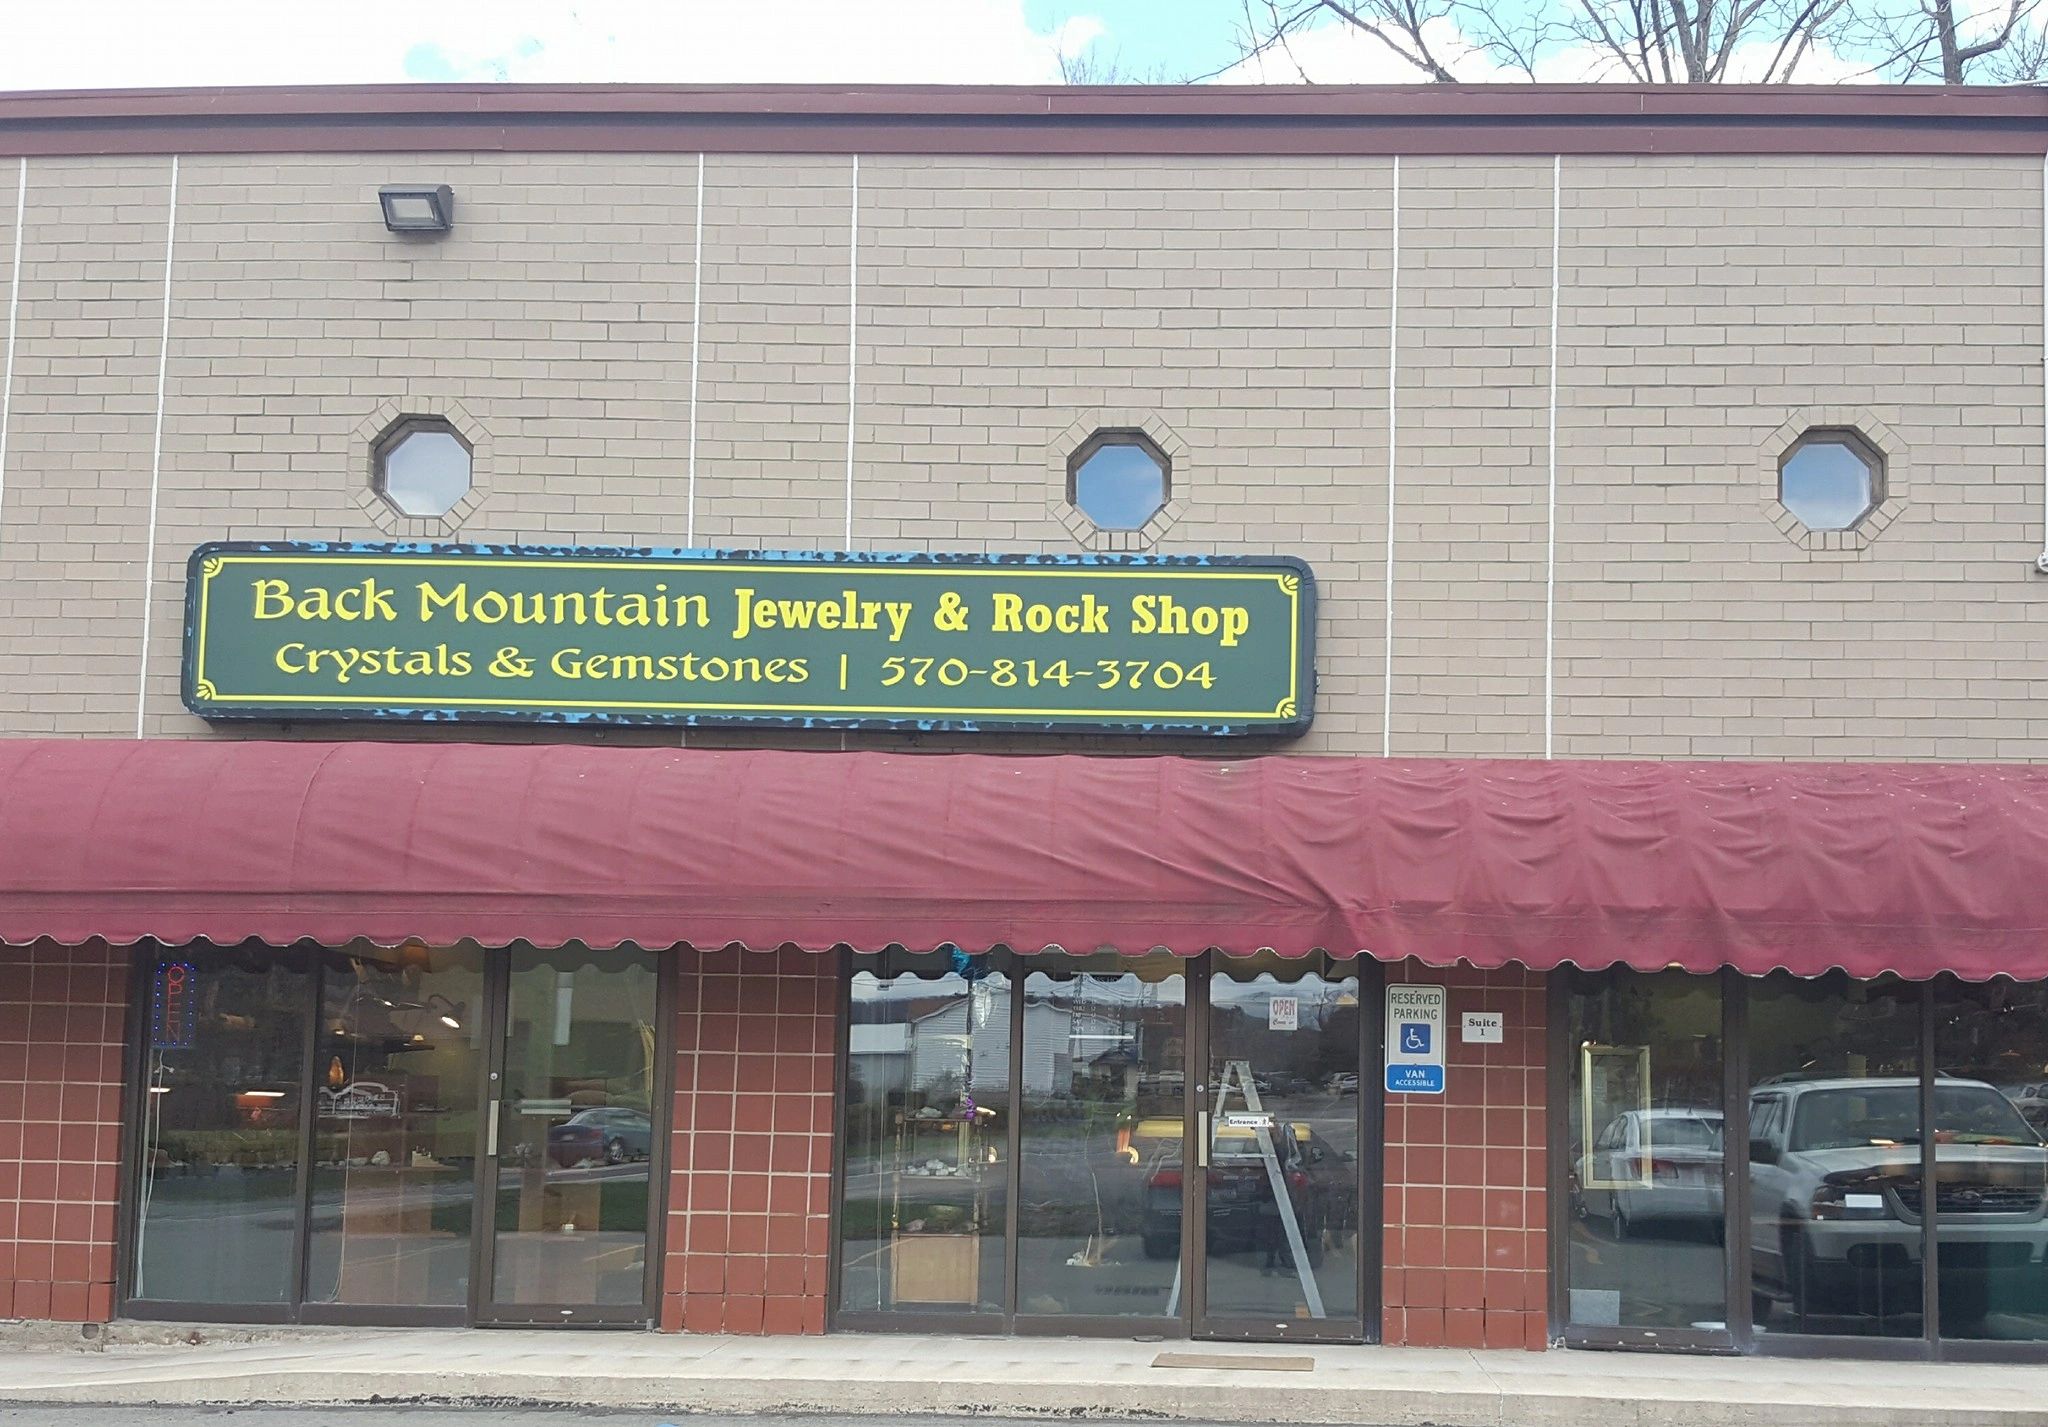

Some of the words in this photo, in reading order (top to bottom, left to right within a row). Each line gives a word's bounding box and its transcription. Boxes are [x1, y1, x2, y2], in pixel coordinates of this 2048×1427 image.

[252, 578, 397, 623] Back
[416, 582, 710, 628] Mountain
[733, 587, 912, 642] Jewelry
[933, 592, 969, 633] &
[992, 592, 1111, 635] Rock
[1130, 594, 1251, 647] Shop
[275, 642, 472, 684] Crystals
[488, 646, 534, 680] &
[551, 647, 809, 684] Gemstones
[880, 655, 1218, 691] 570-814-3704
[167, 966, 185, 1041] OPEN
[1390, 992, 1441, 1005] RESERVED
[1272, 999, 1296, 1016] OPEN
[1393, 1008, 1438, 1020] PARKING
[1468, 1018, 1498, 1028] Suite
[1405, 1069, 1426, 1079] VAN
[1395, 1079, 1435, 1087] ACCESSIBLE
